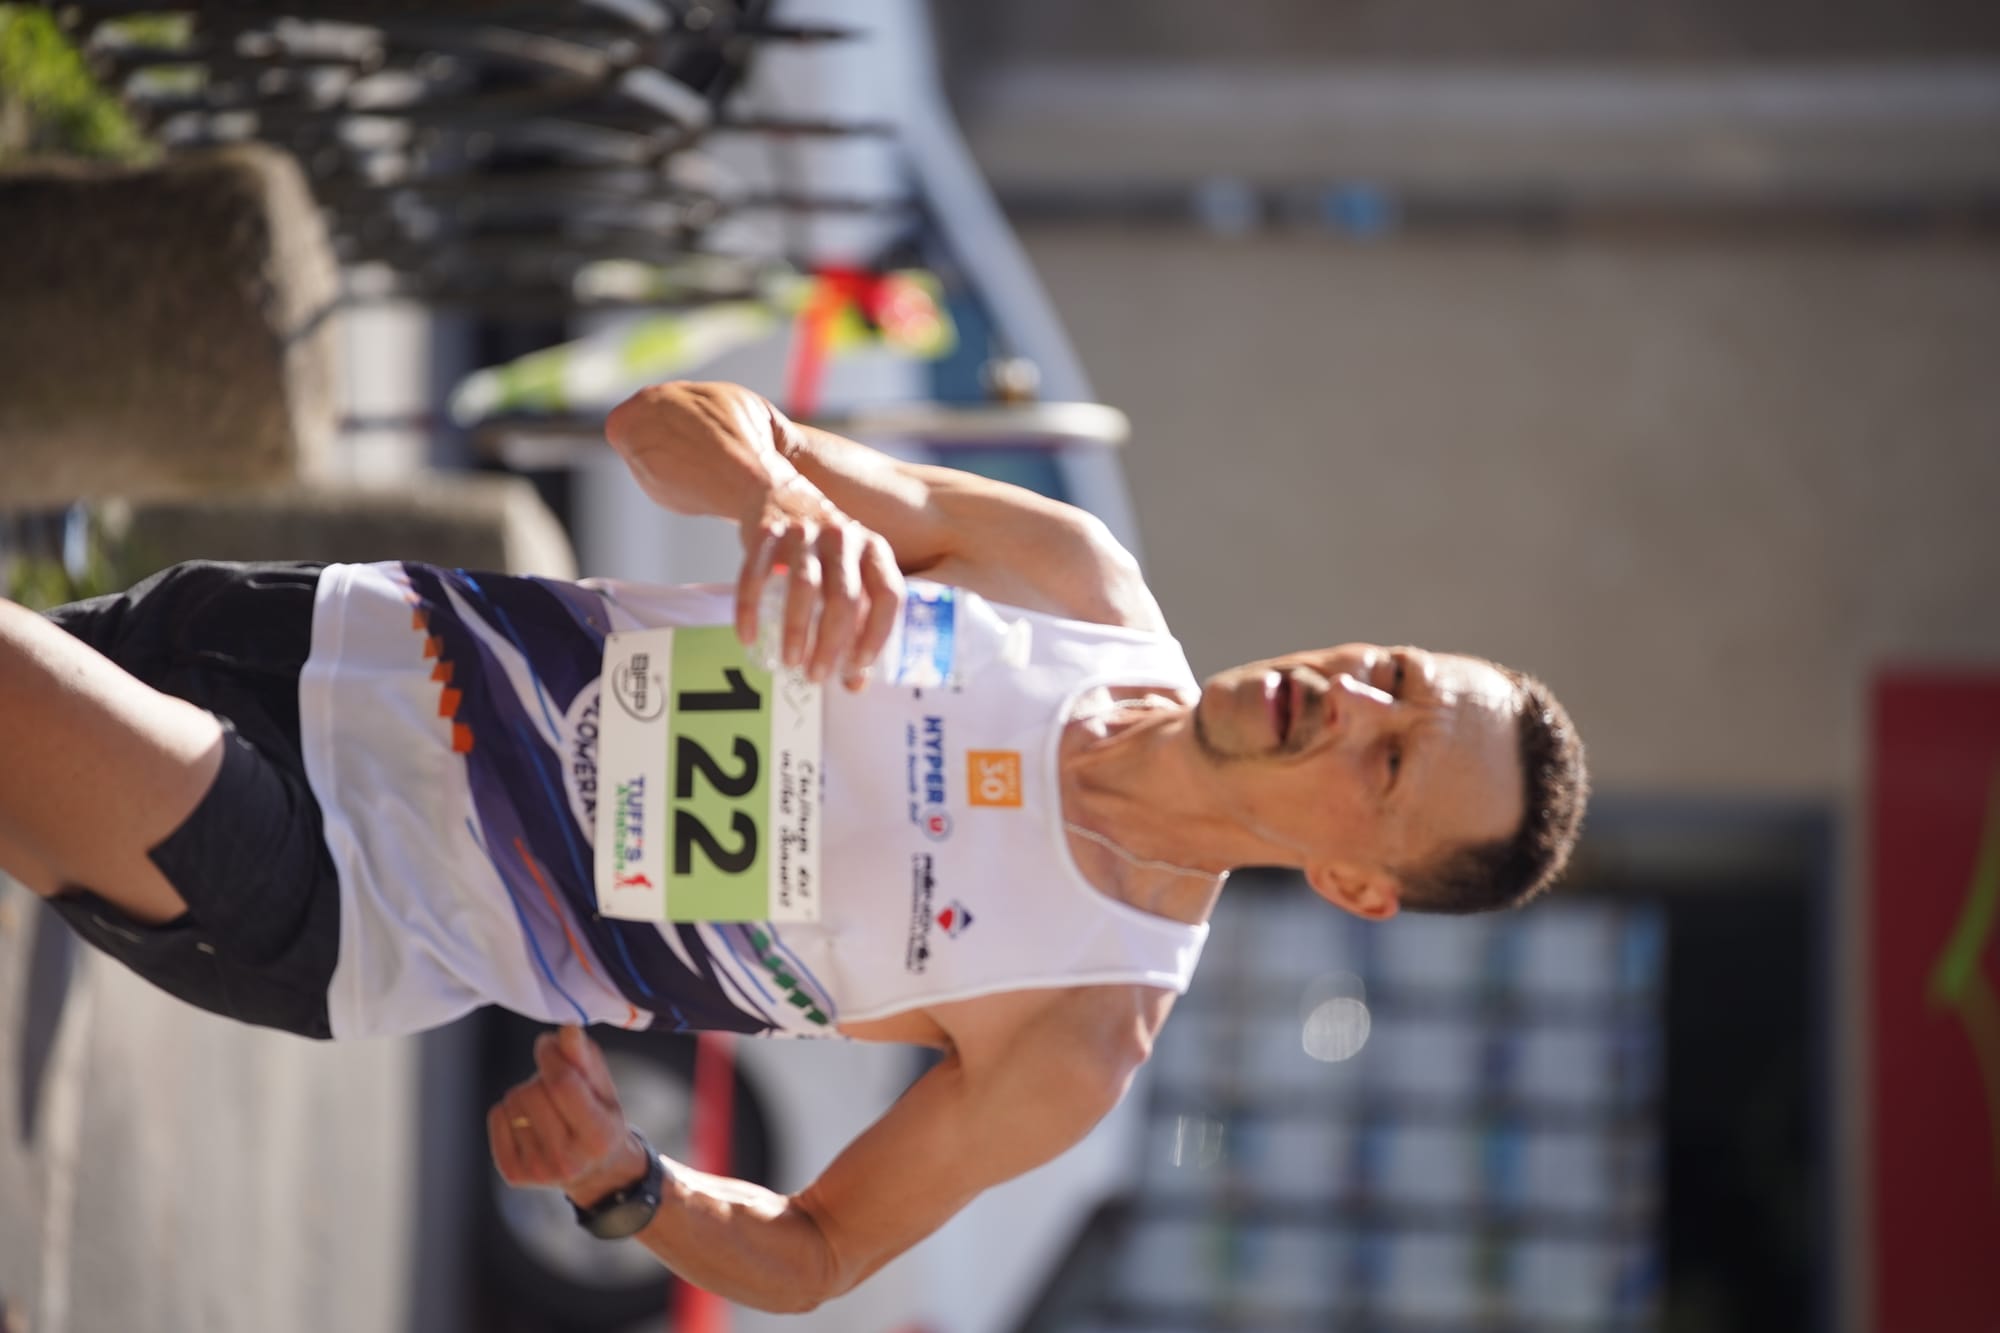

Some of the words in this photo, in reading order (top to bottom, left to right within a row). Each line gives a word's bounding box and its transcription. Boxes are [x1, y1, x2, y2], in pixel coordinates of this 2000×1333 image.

[573, 695, 600, 827] LOMERA
[673, 667, 763, 876] 122
[924, 716, 946, 803] HYPER
[624, 776, 646, 863] TUFF'S
